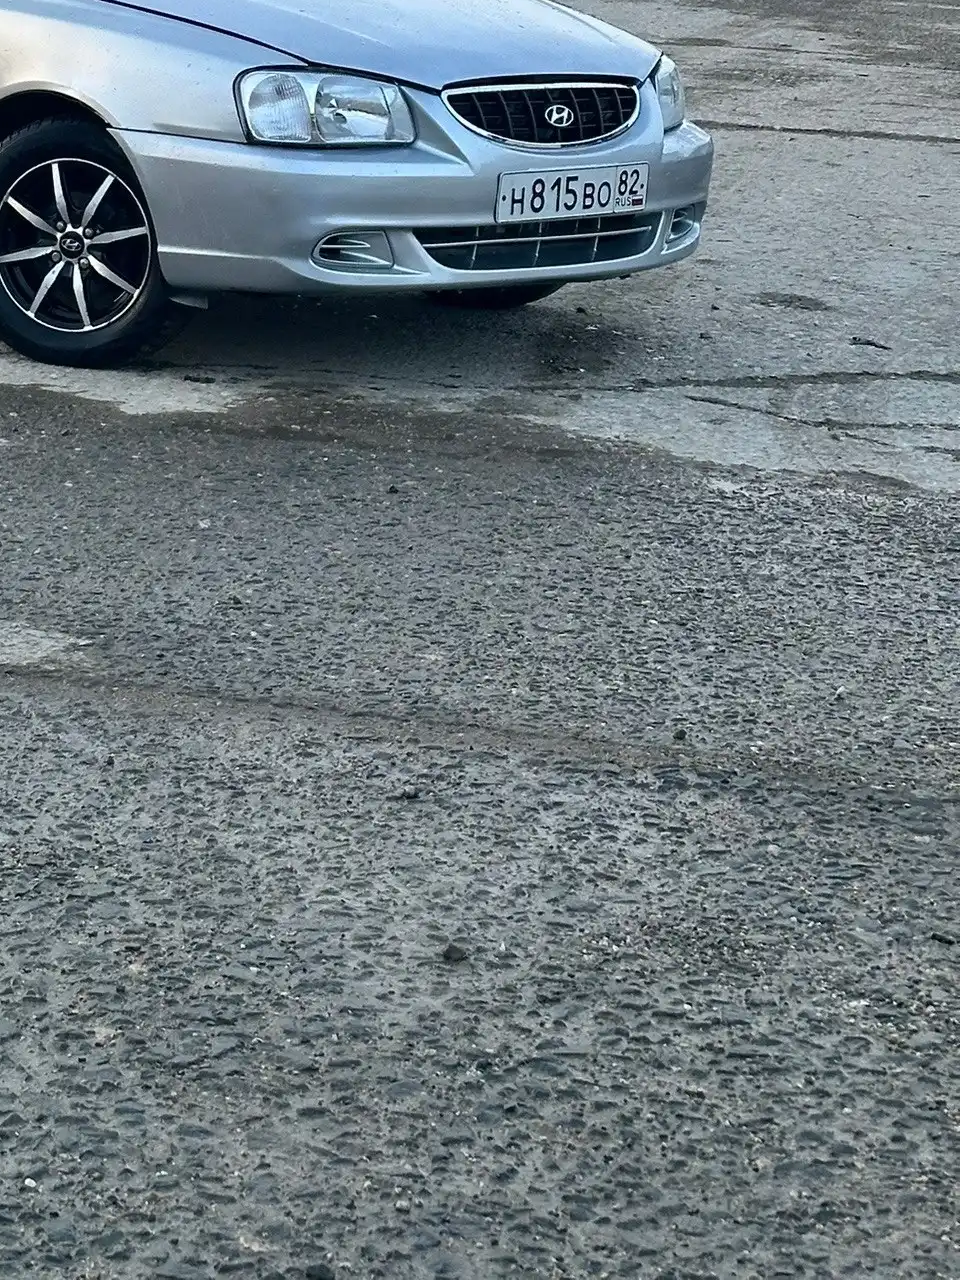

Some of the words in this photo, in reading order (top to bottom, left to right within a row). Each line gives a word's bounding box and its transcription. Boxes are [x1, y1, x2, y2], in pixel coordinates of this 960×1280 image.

[510, 176, 612, 216] Н815ВО
[617, 169, 640, 196] 82
[615, 195, 632, 207] RUS
